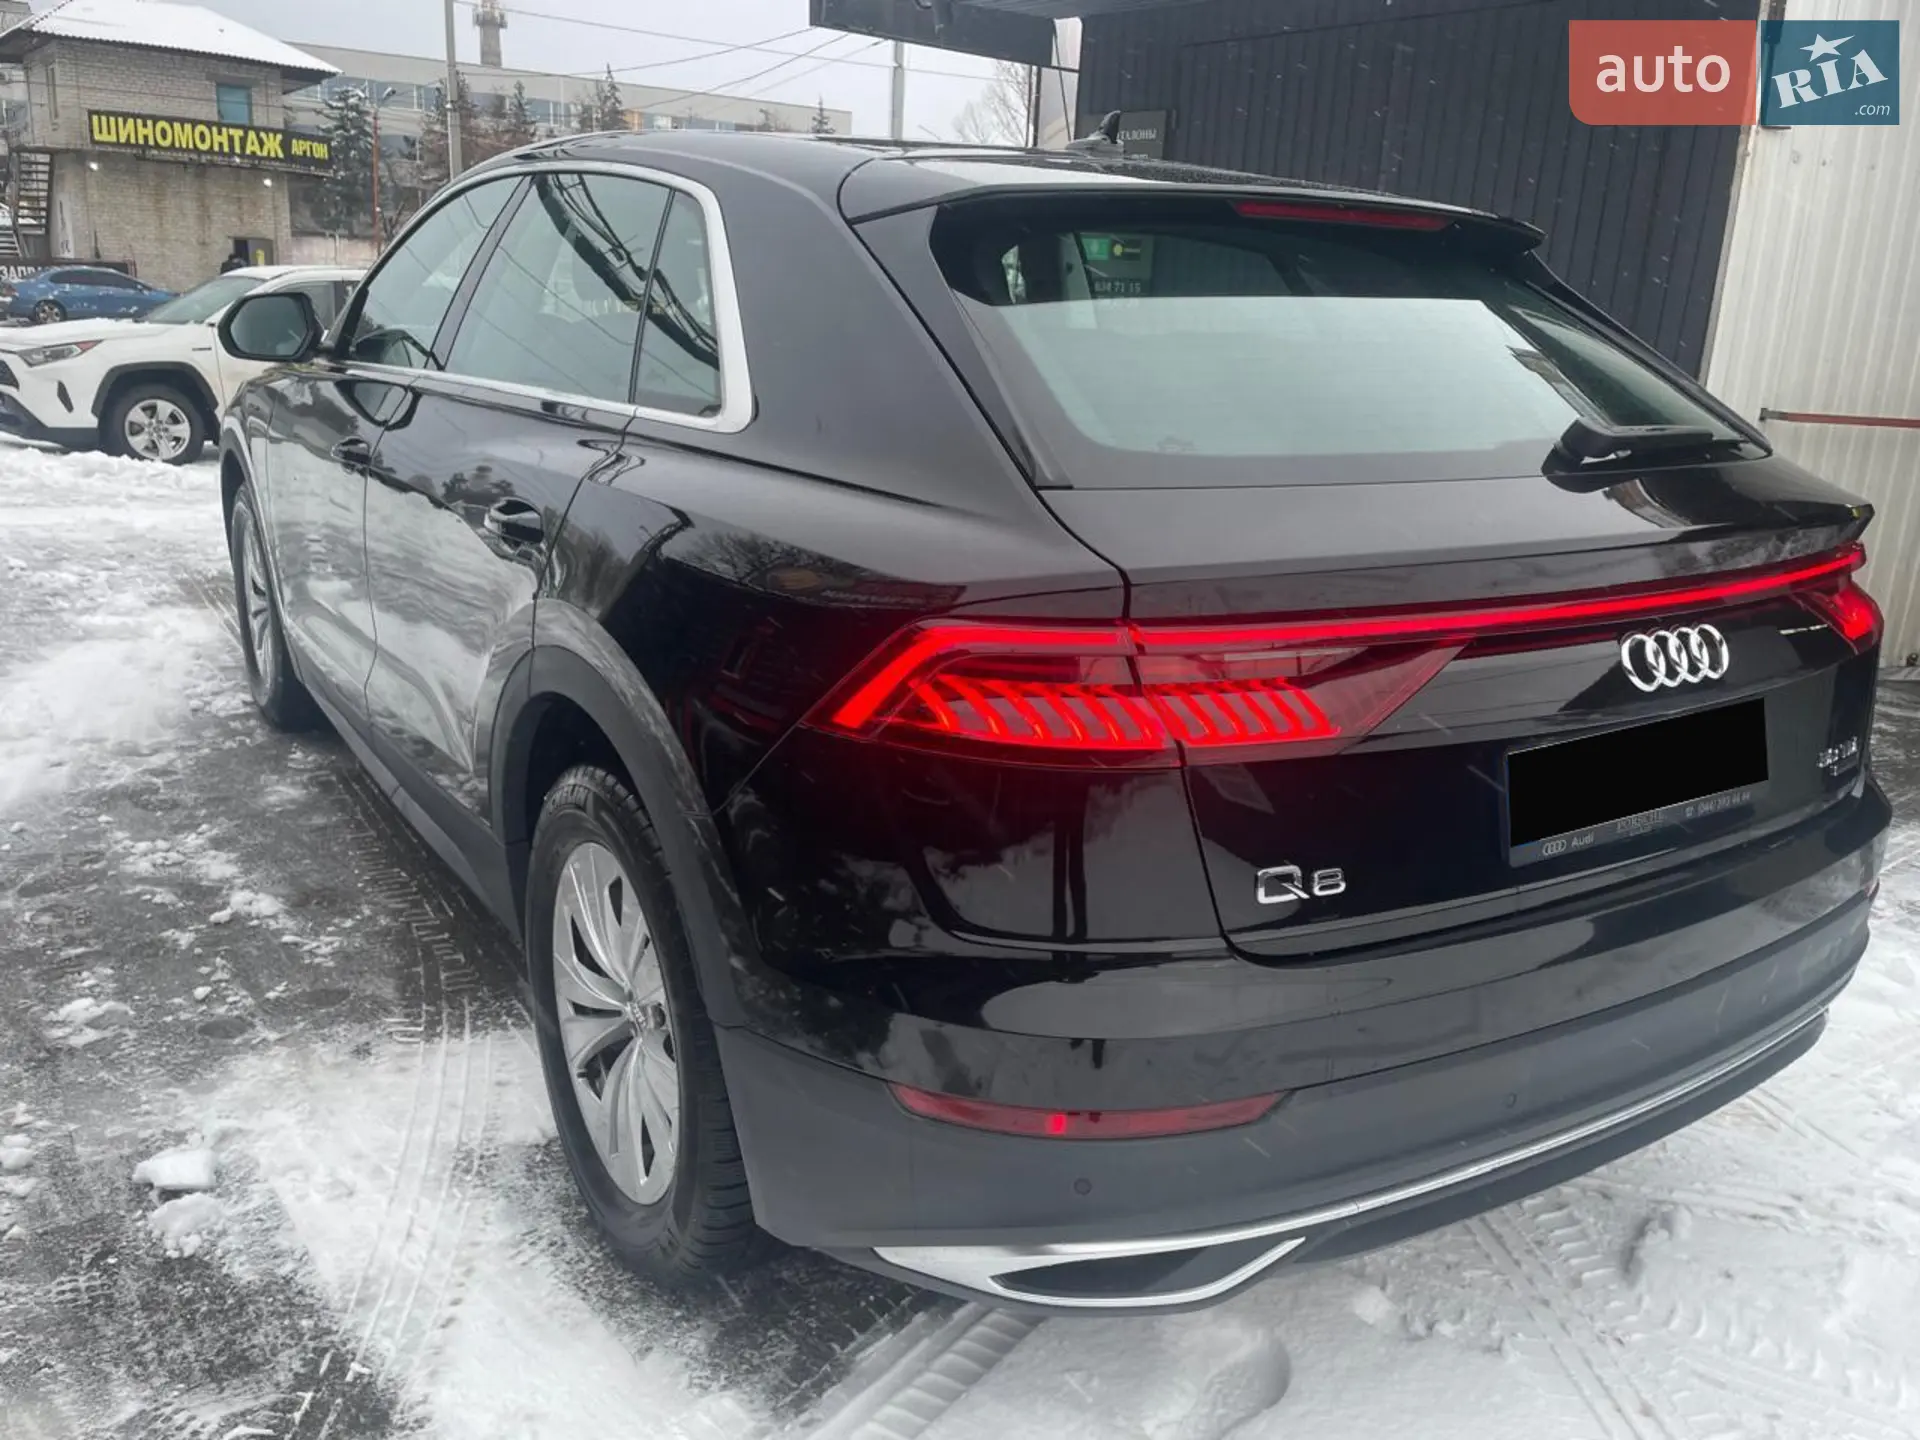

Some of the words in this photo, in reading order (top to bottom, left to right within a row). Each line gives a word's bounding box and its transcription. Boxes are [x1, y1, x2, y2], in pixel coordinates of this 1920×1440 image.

[92, 114, 284, 159] ШИНОМОНТАЖ
[291, 138, 329, 160] АРГОН
[0, 265, 42, 281] ЗАПР
[1571, 830, 1594, 850] Audi
[1257, 865, 1346, 904] Q8
